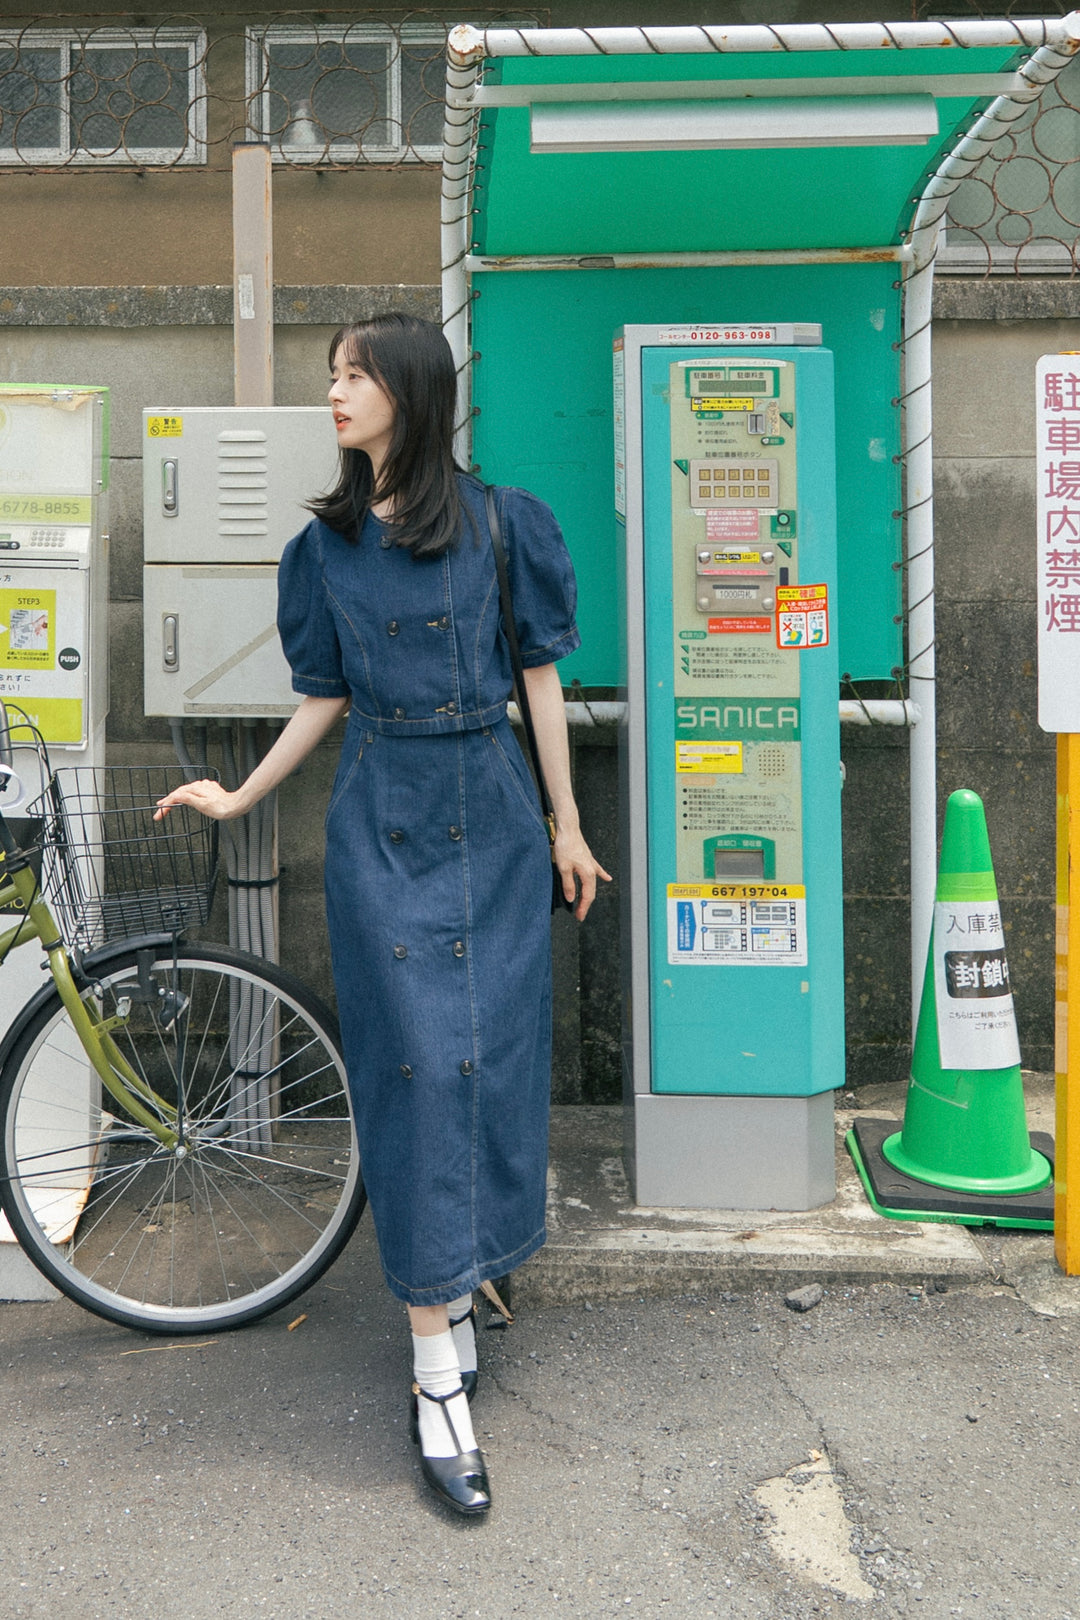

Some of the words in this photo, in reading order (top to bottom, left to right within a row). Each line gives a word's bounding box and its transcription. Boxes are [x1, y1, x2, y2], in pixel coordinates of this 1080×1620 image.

[691, 331, 771, 340] 0120-963-098
[1044, 372, 1080, 633] 駐車場内禁煙
[720, 591, 752, 599] 1000円札
[17, 597, 40, 605] STEP3
[60, 655, 79, 663] PUSH
[677, 706, 798, 728] SANICA
[712, 887, 736, 896] 667
